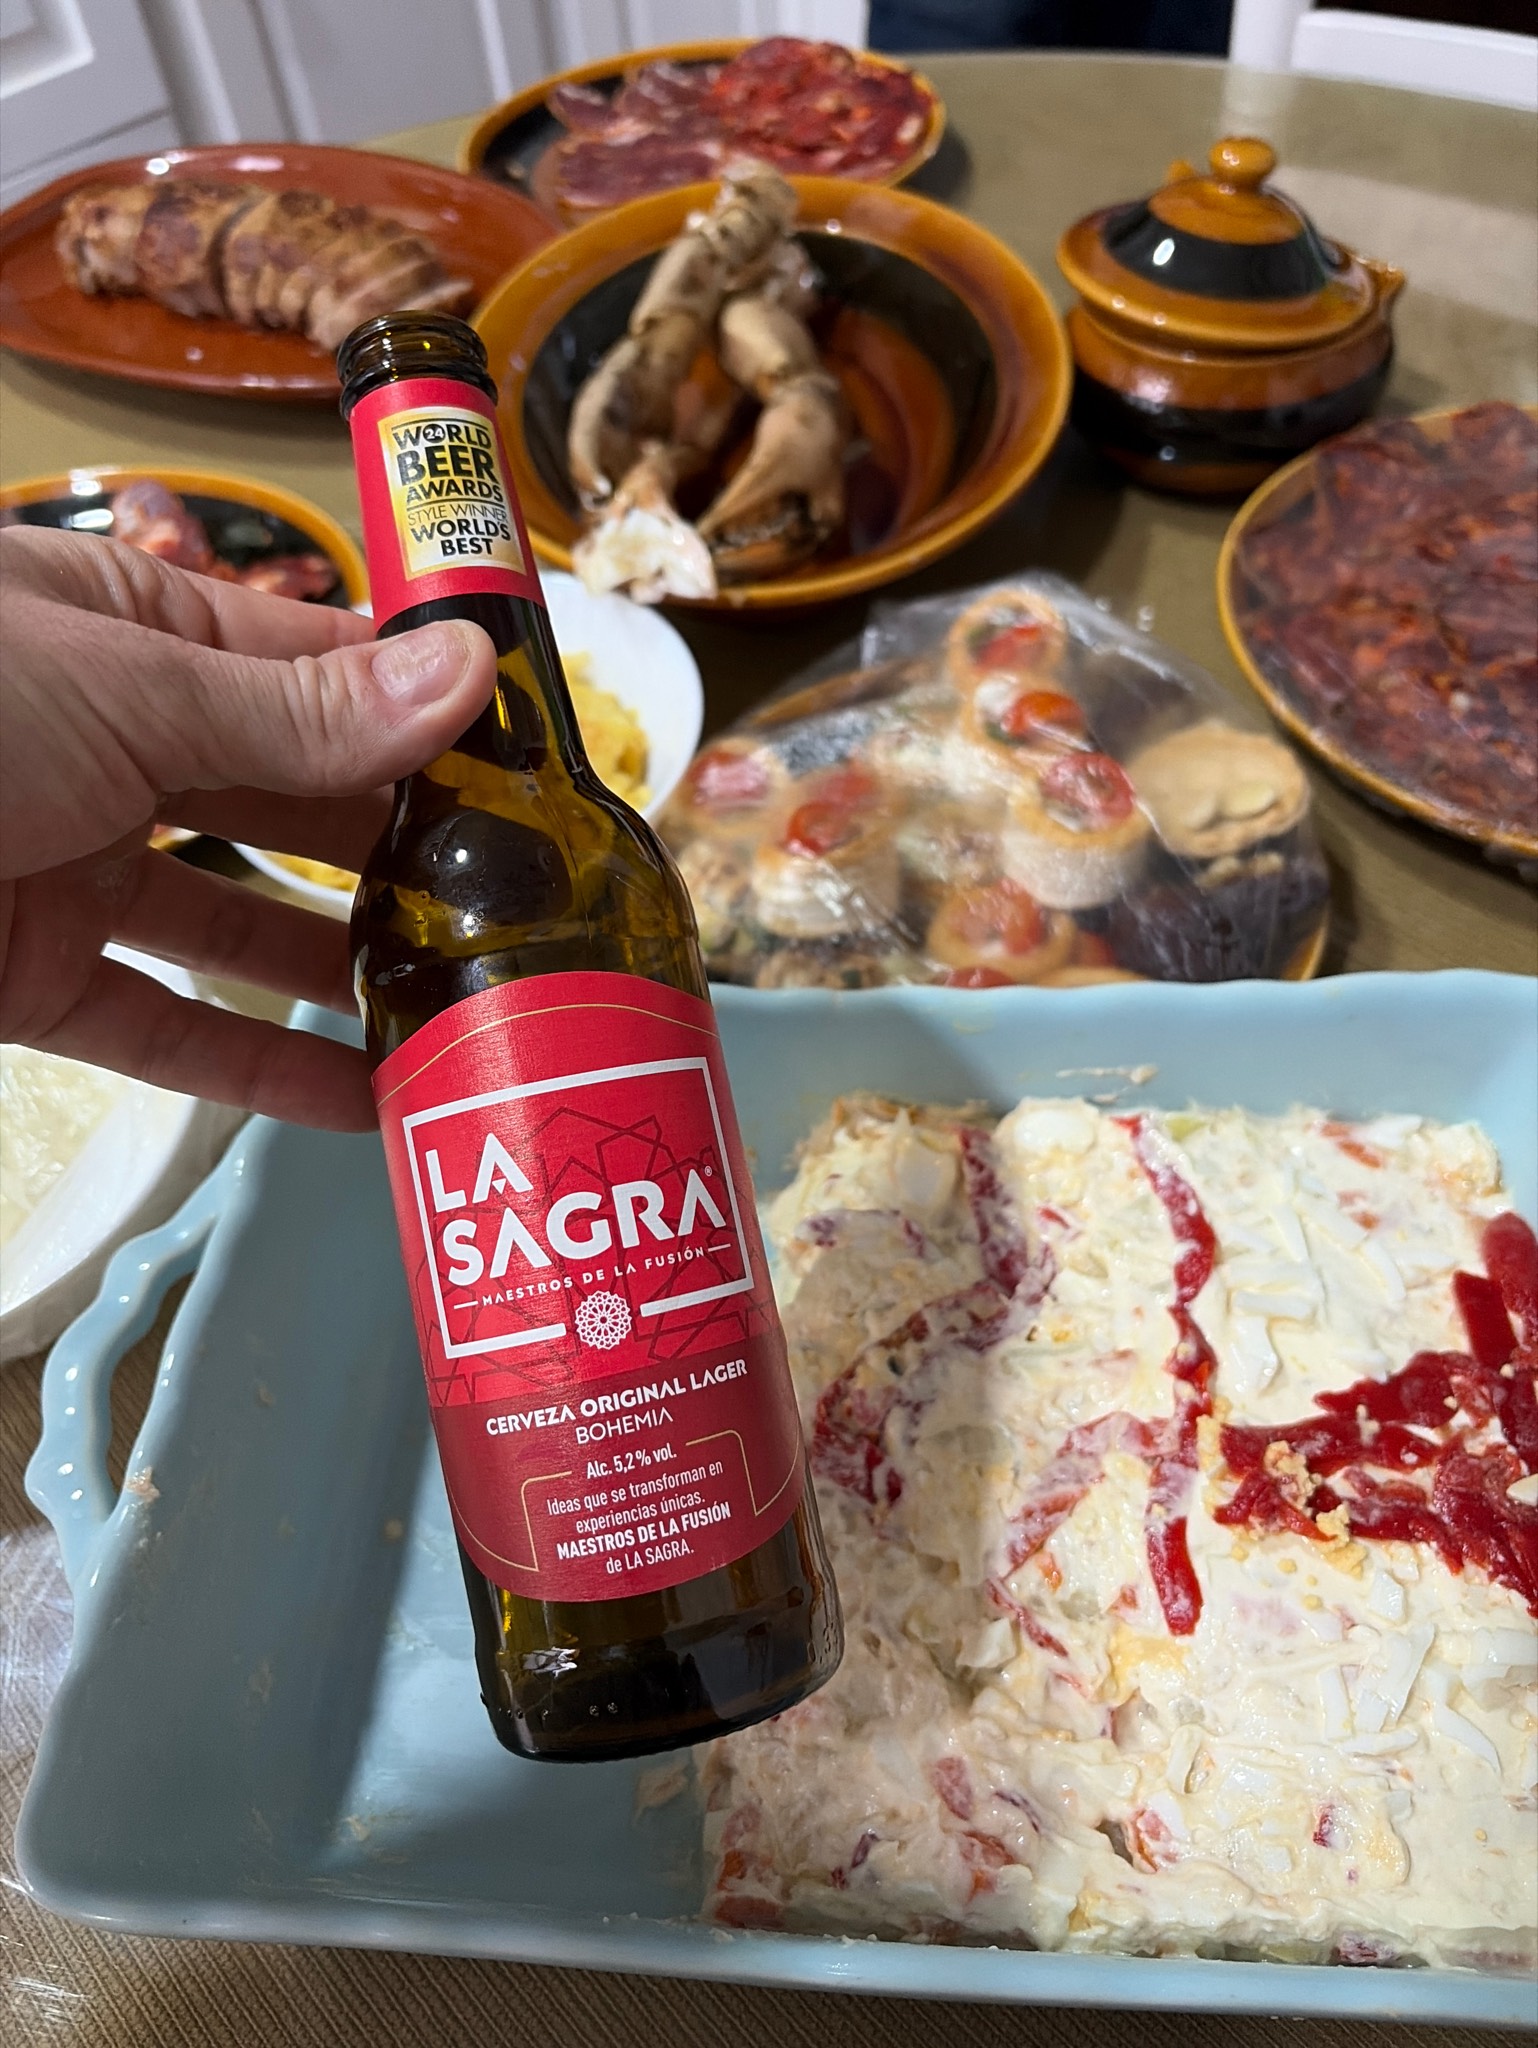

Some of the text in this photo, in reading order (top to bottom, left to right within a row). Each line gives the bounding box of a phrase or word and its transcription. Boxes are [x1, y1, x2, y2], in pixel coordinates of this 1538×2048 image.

[392, 423, 492, 450] WORLD
[397, 444, 499, 486] BEER
[407, 479, 503, 505] AWARDS
[408, 504, 508, 526] STYLE WINNER
[411, 518, 511, 543] WORLD'S
[440, 537, 494, 557] BEST
[425, 1132, 534, 1213] LA
[482, 1246, 704, 1306] MAESTROS DE LA FUSIÓN
[486, 1358, 748, 1436] CERVEZA ORIGINAL LAGER
[575, 1406, 674, 1445] BOHEMIA
[586, 1460, 613, 1479] Alc.
[653, 1442, 677, 1462] vol.
[547, 1460, 723, 1516] Ideas que se transforman en
[556, 1500, 731, 1560] MAESTROS DE LA FUSIÓN
[576, 1491, 705, 1535] experiencias únicas.
[606, 1538, 694, 1574] de LA SAGRA.
